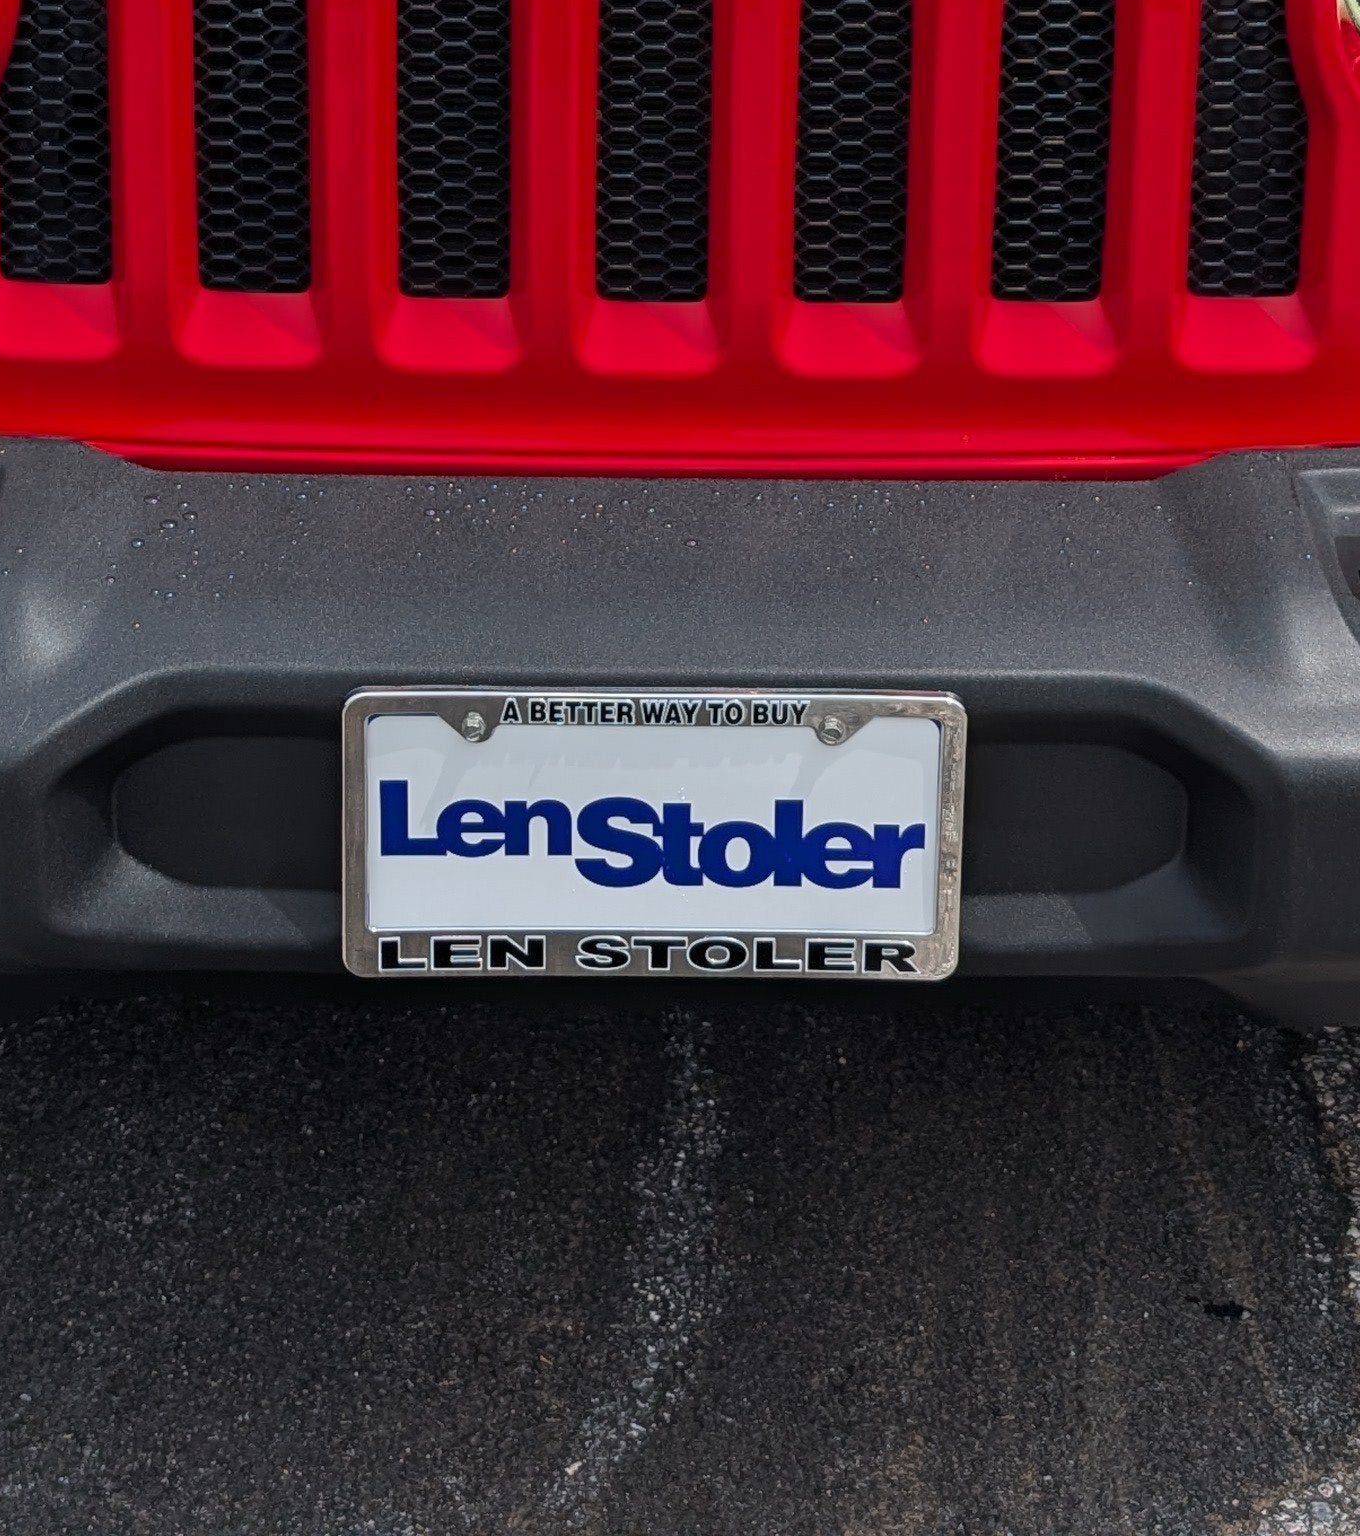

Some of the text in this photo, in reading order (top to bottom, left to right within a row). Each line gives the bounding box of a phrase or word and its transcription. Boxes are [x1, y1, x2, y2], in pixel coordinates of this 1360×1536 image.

[499, 697, 811, 726] A BETTER WAY TO BUY
[378, 935, 922, 974] LEN STOLER
